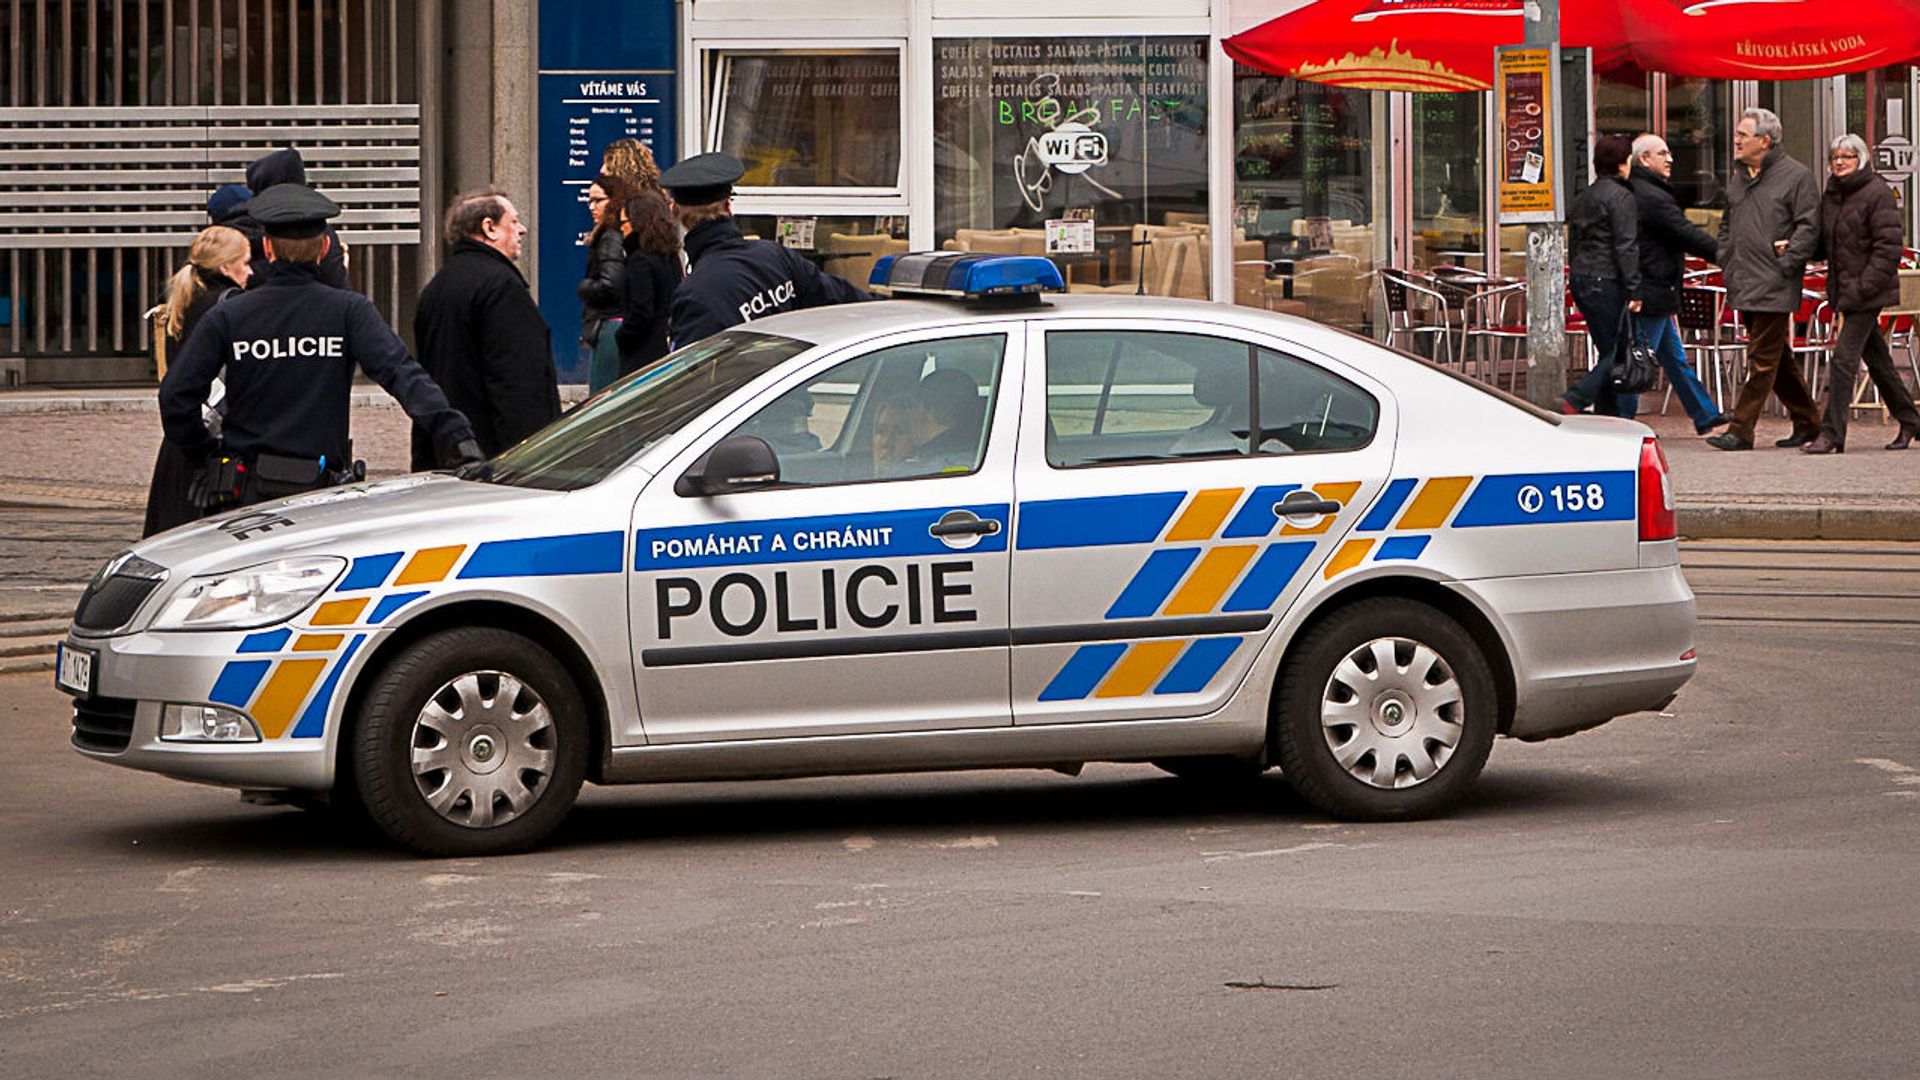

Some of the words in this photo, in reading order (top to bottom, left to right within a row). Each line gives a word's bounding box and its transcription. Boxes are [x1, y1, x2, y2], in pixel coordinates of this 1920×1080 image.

[941, 46, 980, 59] COFFEE
[987, 46, 1041, 59] COCTAILS
[1047, 45, 1091, 58] SALADS
[1098, 44, 1132, 57] PASTA
[1139, 44, 1202, 57] BREAKFAST
[1735, 39, 1829, 58] KŘIVOKLÁTSKÁ
[1829, 34, 1866, 52] VODA
[941, 65, 984, 79] SALADS
[1149, 63, 1203, 77] COCTAILS
[580, 80, 624, 96] VÍTÁME
[626, 80, 647, 96] VÁS
[941, 84, 980, 98] COFFEE
[988, 83, 1041, 97] COCTAILS
[1048, 84, 1091, 97] SALADS
[1098, 83, 1132, 96] PASTA
[1139, 83, 1202, 96] BREAKFAST
[232, 336, 344, 361] POLICIE
[1550, 483, 1605, 511] 158
[651, 533, 763, 559] POMÁHAT
[770, 534, 787, 552] A
[793, 527, 894, 551] CHRÁNIT
[655, 561, 978, 640] POLICIE
